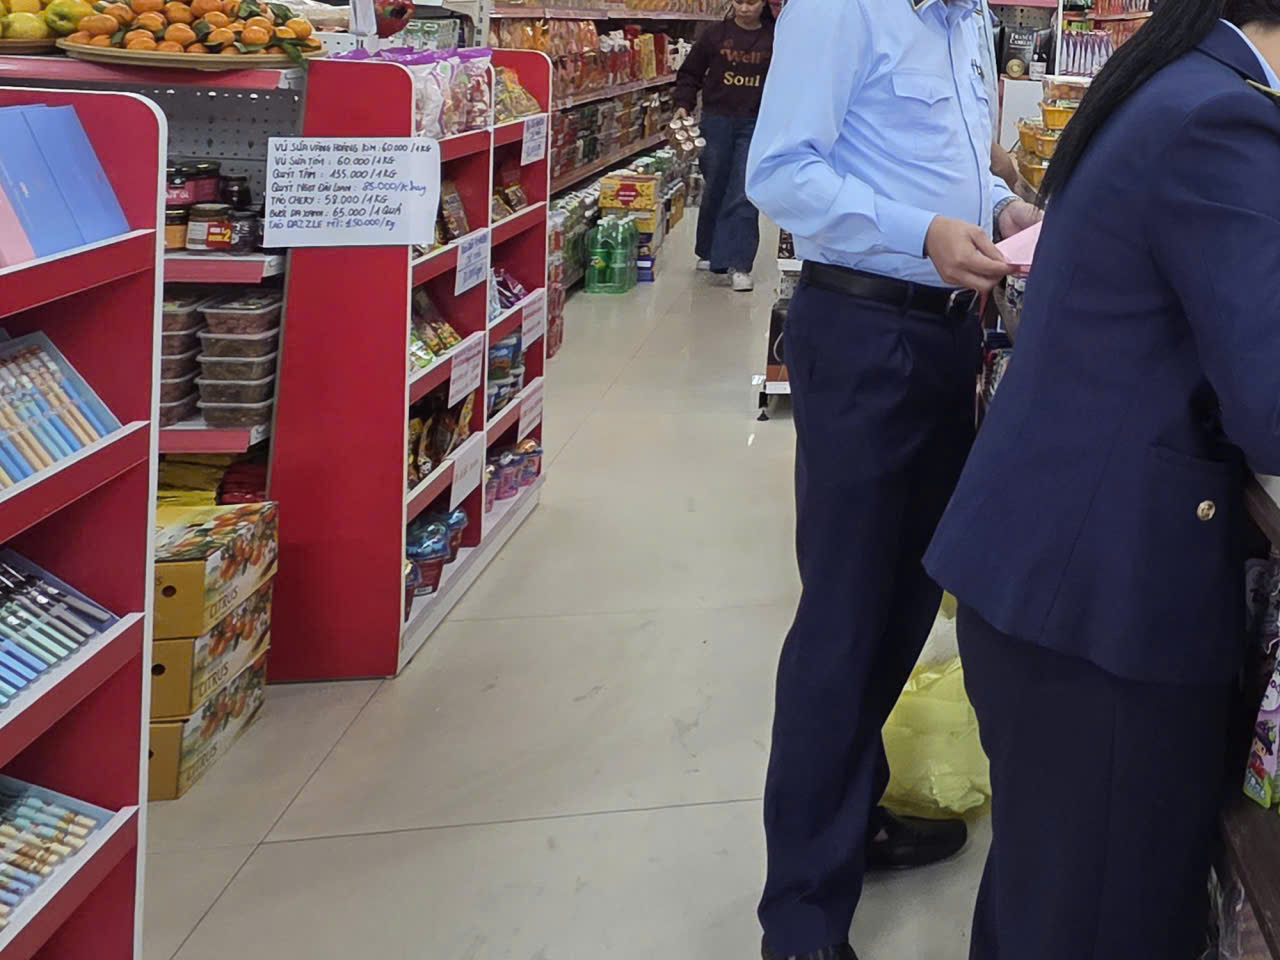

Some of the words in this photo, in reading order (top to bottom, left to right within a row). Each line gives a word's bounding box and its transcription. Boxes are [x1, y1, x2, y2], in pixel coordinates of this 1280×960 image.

[723, 71, 760, 87] Soul
[208, 588, 239, 620] CITRUS
[200, 661, 229, 698] CITRUS
